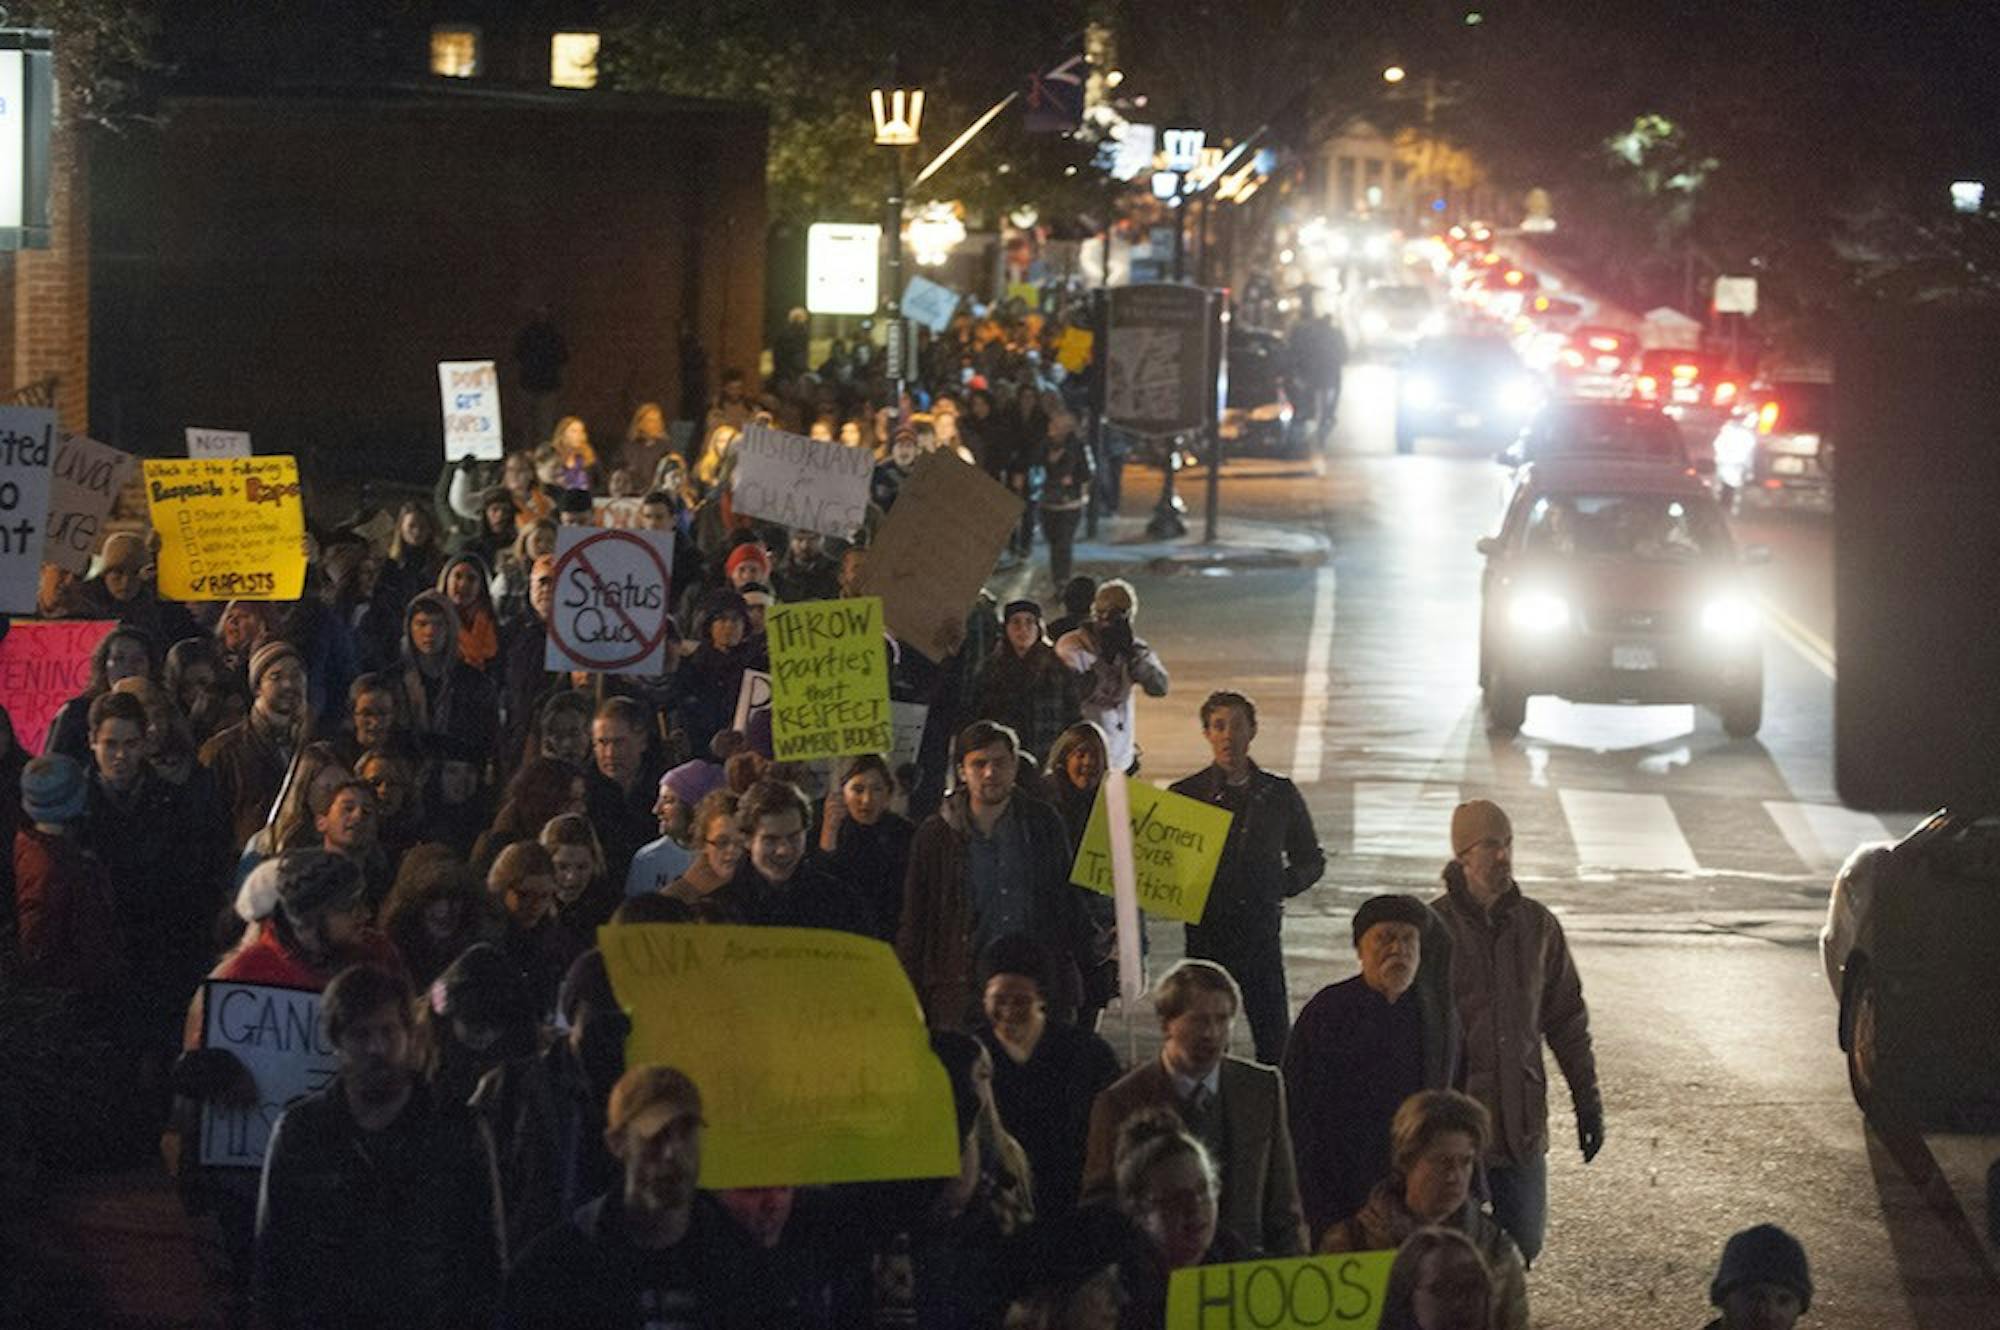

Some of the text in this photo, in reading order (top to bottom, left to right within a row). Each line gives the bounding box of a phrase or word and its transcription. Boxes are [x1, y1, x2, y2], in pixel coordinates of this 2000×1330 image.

[0, 424, 52, 467] ted
[195, 435, 240, 450] NOT
[208, 571, 276, 592] RAPISTS
[563, 567, 662, 610] Status
[573, 606, 638, 643] Quo
[769, 602, 874, 652] THROW
[0, 655, 93, 690] ENING
[776, 647, 875, 695] parties
[805, 680, 850, 701] that
[778, 698, 886, 733] RESPECT
[842, 721, 891, 751] BODIES
[1086, 851, 1184, 906] Trition
[1197, 1258, 1372, 1330] HOOS
